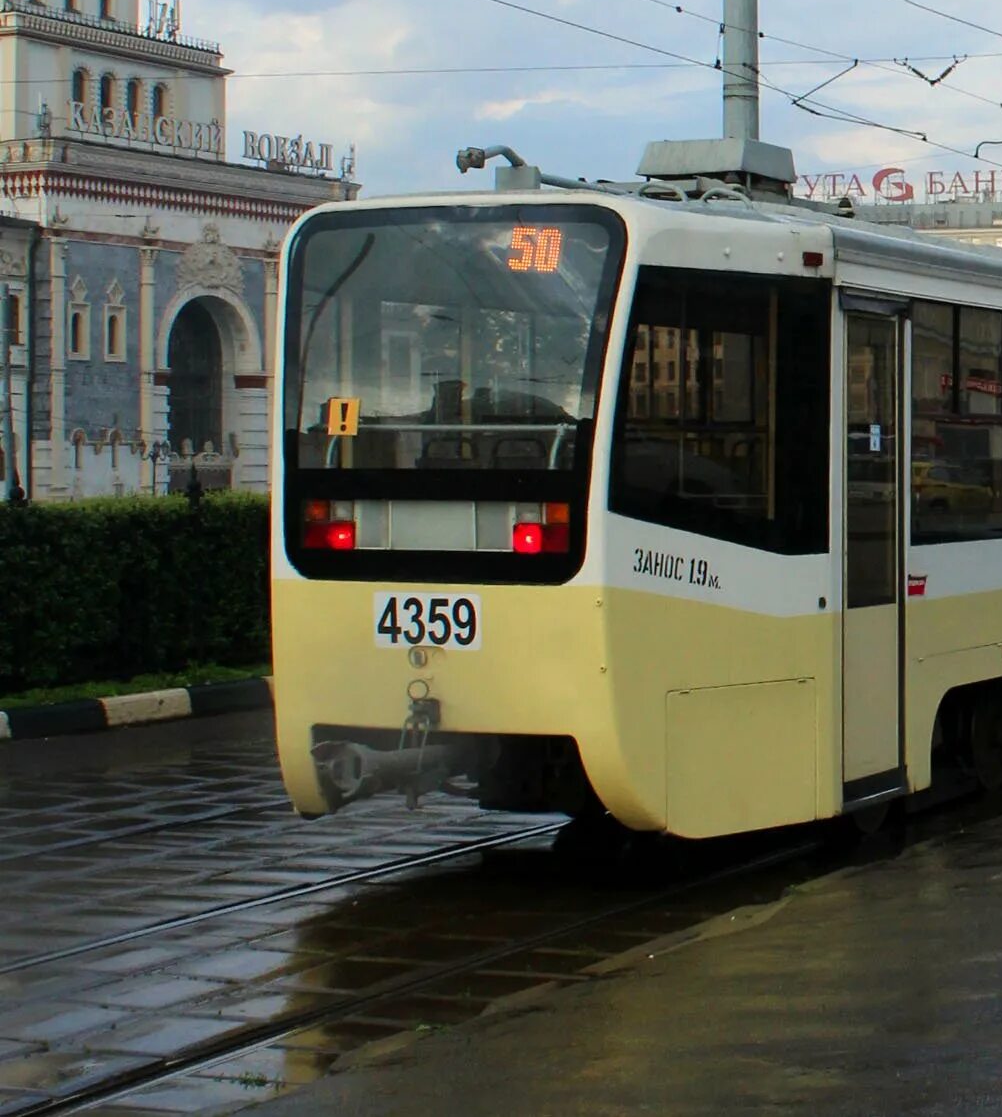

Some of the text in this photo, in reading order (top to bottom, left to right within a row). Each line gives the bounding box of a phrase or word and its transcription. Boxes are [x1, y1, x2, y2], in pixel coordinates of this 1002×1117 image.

[65, 100, 334, 171] КАЗАНСКИЙ ВОКЗАЛ
[794, 173, 867, 198] УТА
[508, 225, 563, 274] 50
[633, 548, 684, 581] ЗАНОС
[376, 596, 477, 646] 4359
